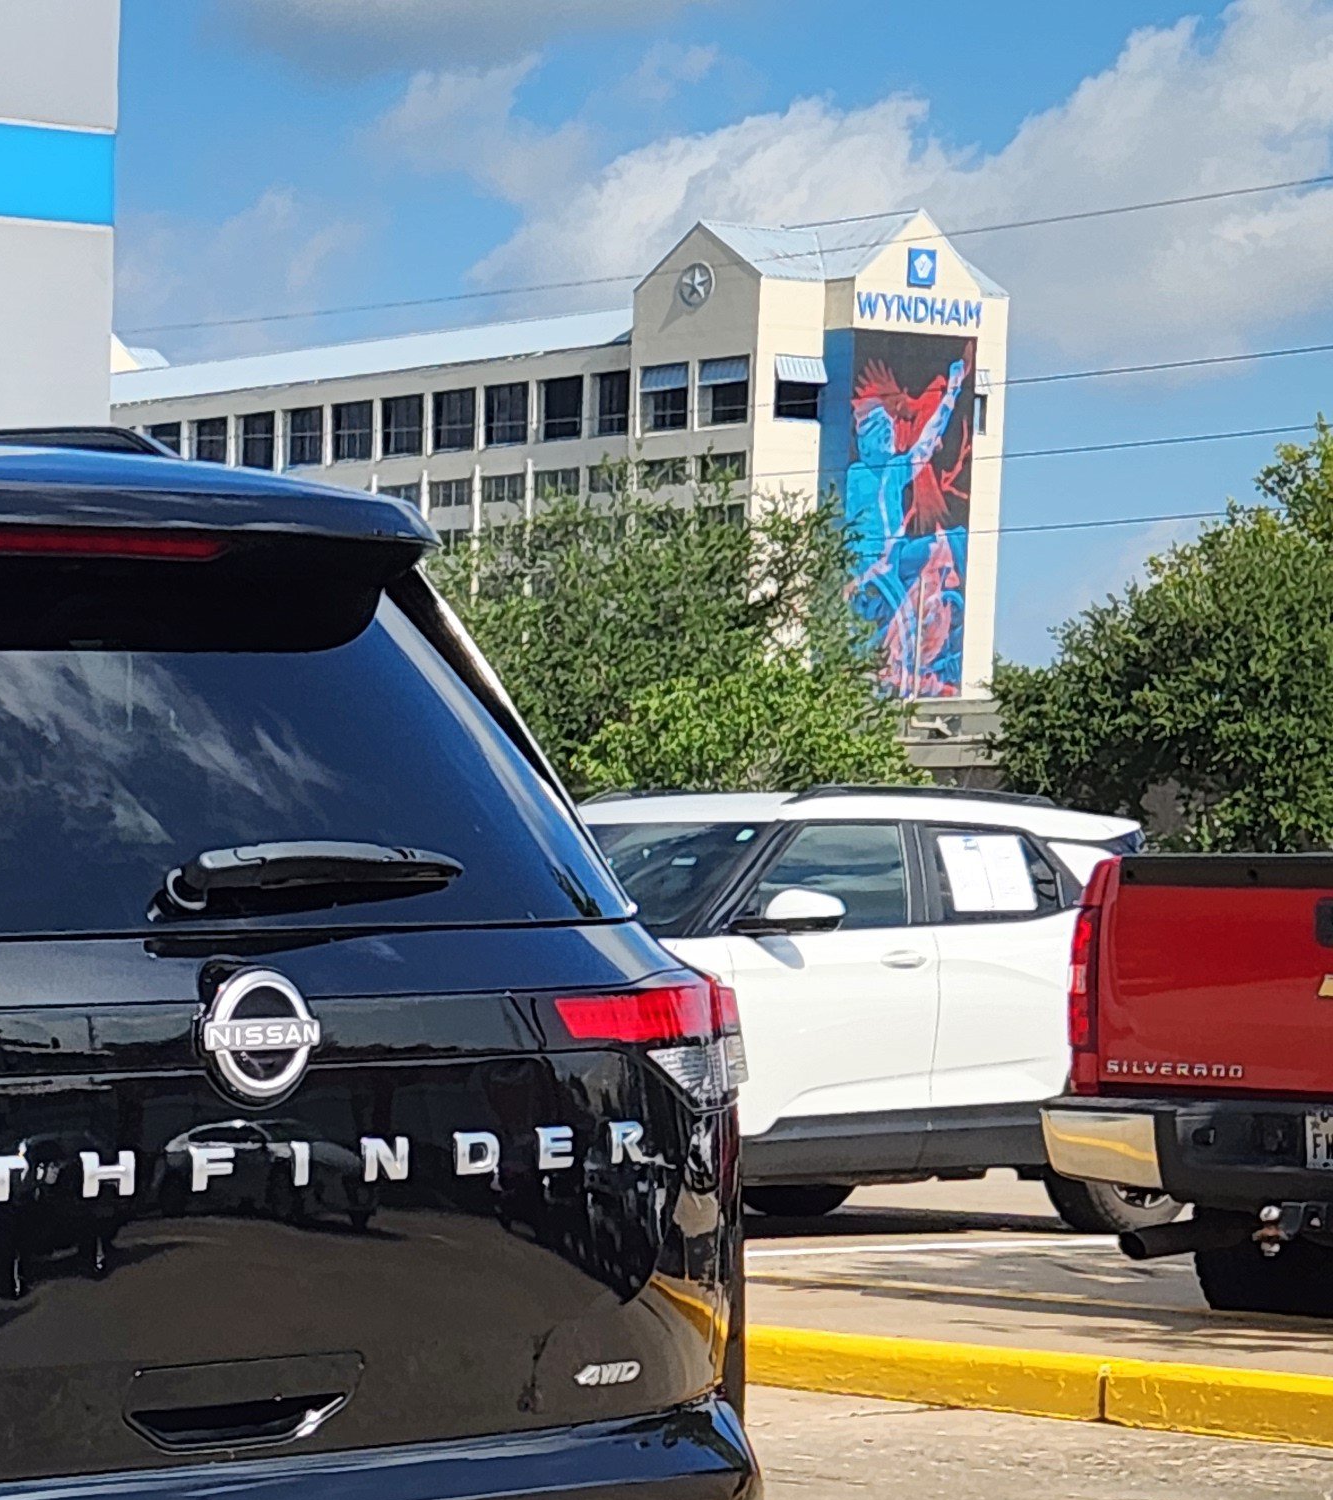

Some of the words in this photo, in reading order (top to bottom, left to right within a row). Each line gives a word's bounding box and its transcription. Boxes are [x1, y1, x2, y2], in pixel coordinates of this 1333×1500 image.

[857, 291, 983, 329] WYNDHAM
[209, 1023, 318, 1047] NISSAN
[574, 1361, 641, 1386] 4WD
